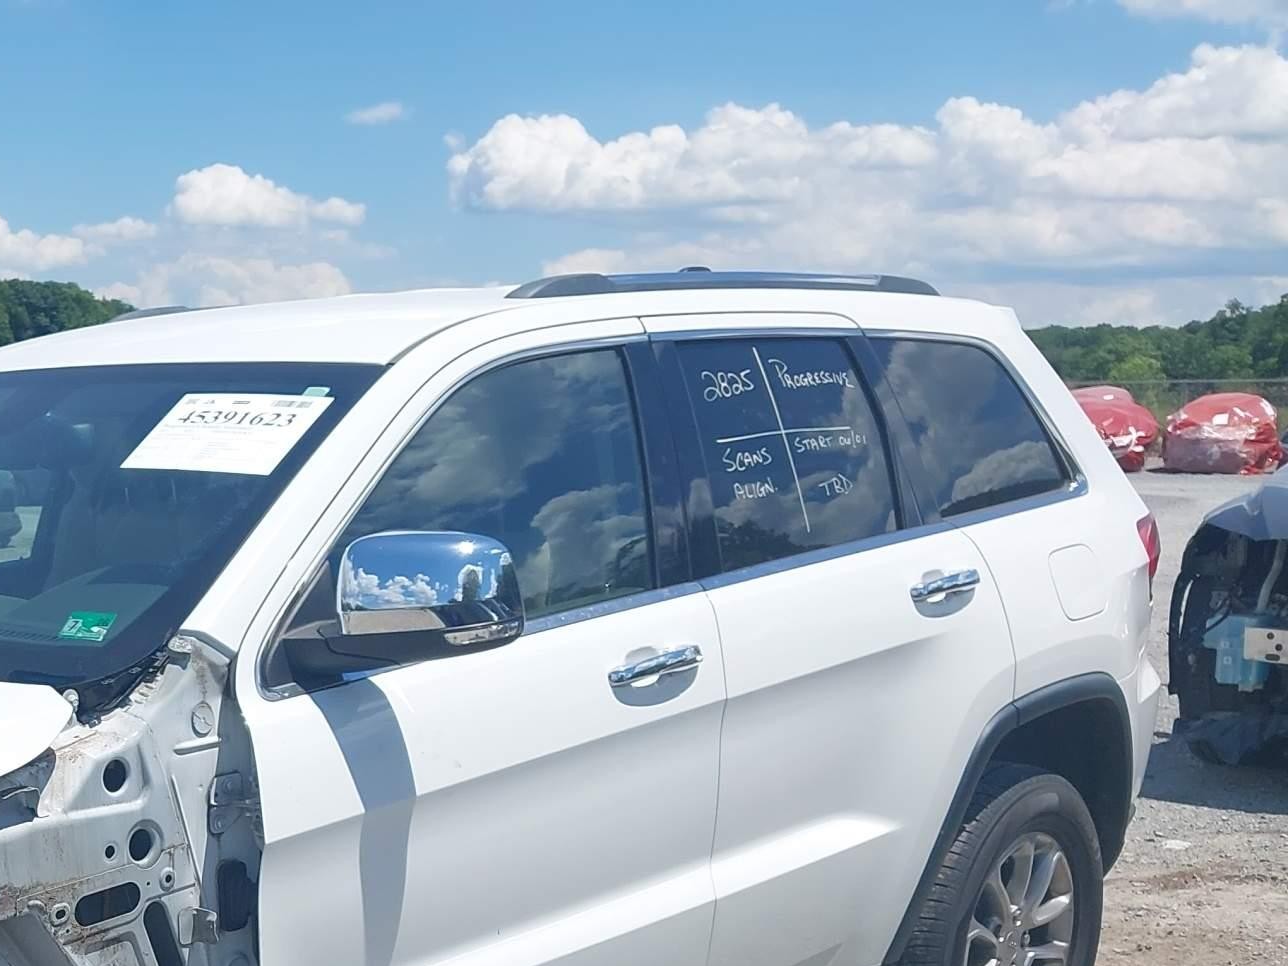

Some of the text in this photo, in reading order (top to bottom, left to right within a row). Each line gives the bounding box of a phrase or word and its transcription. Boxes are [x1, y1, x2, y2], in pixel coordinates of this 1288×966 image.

[701, 369, 754, 402] 2825
[768, 359, 856, 389] PROGRESSIVE
[178, 410, 298, 428] 45391623
[794, 437, 832, 453] START
[722, 448, 773, 472] SCANS
[818, 473, 854, 497] TBD
